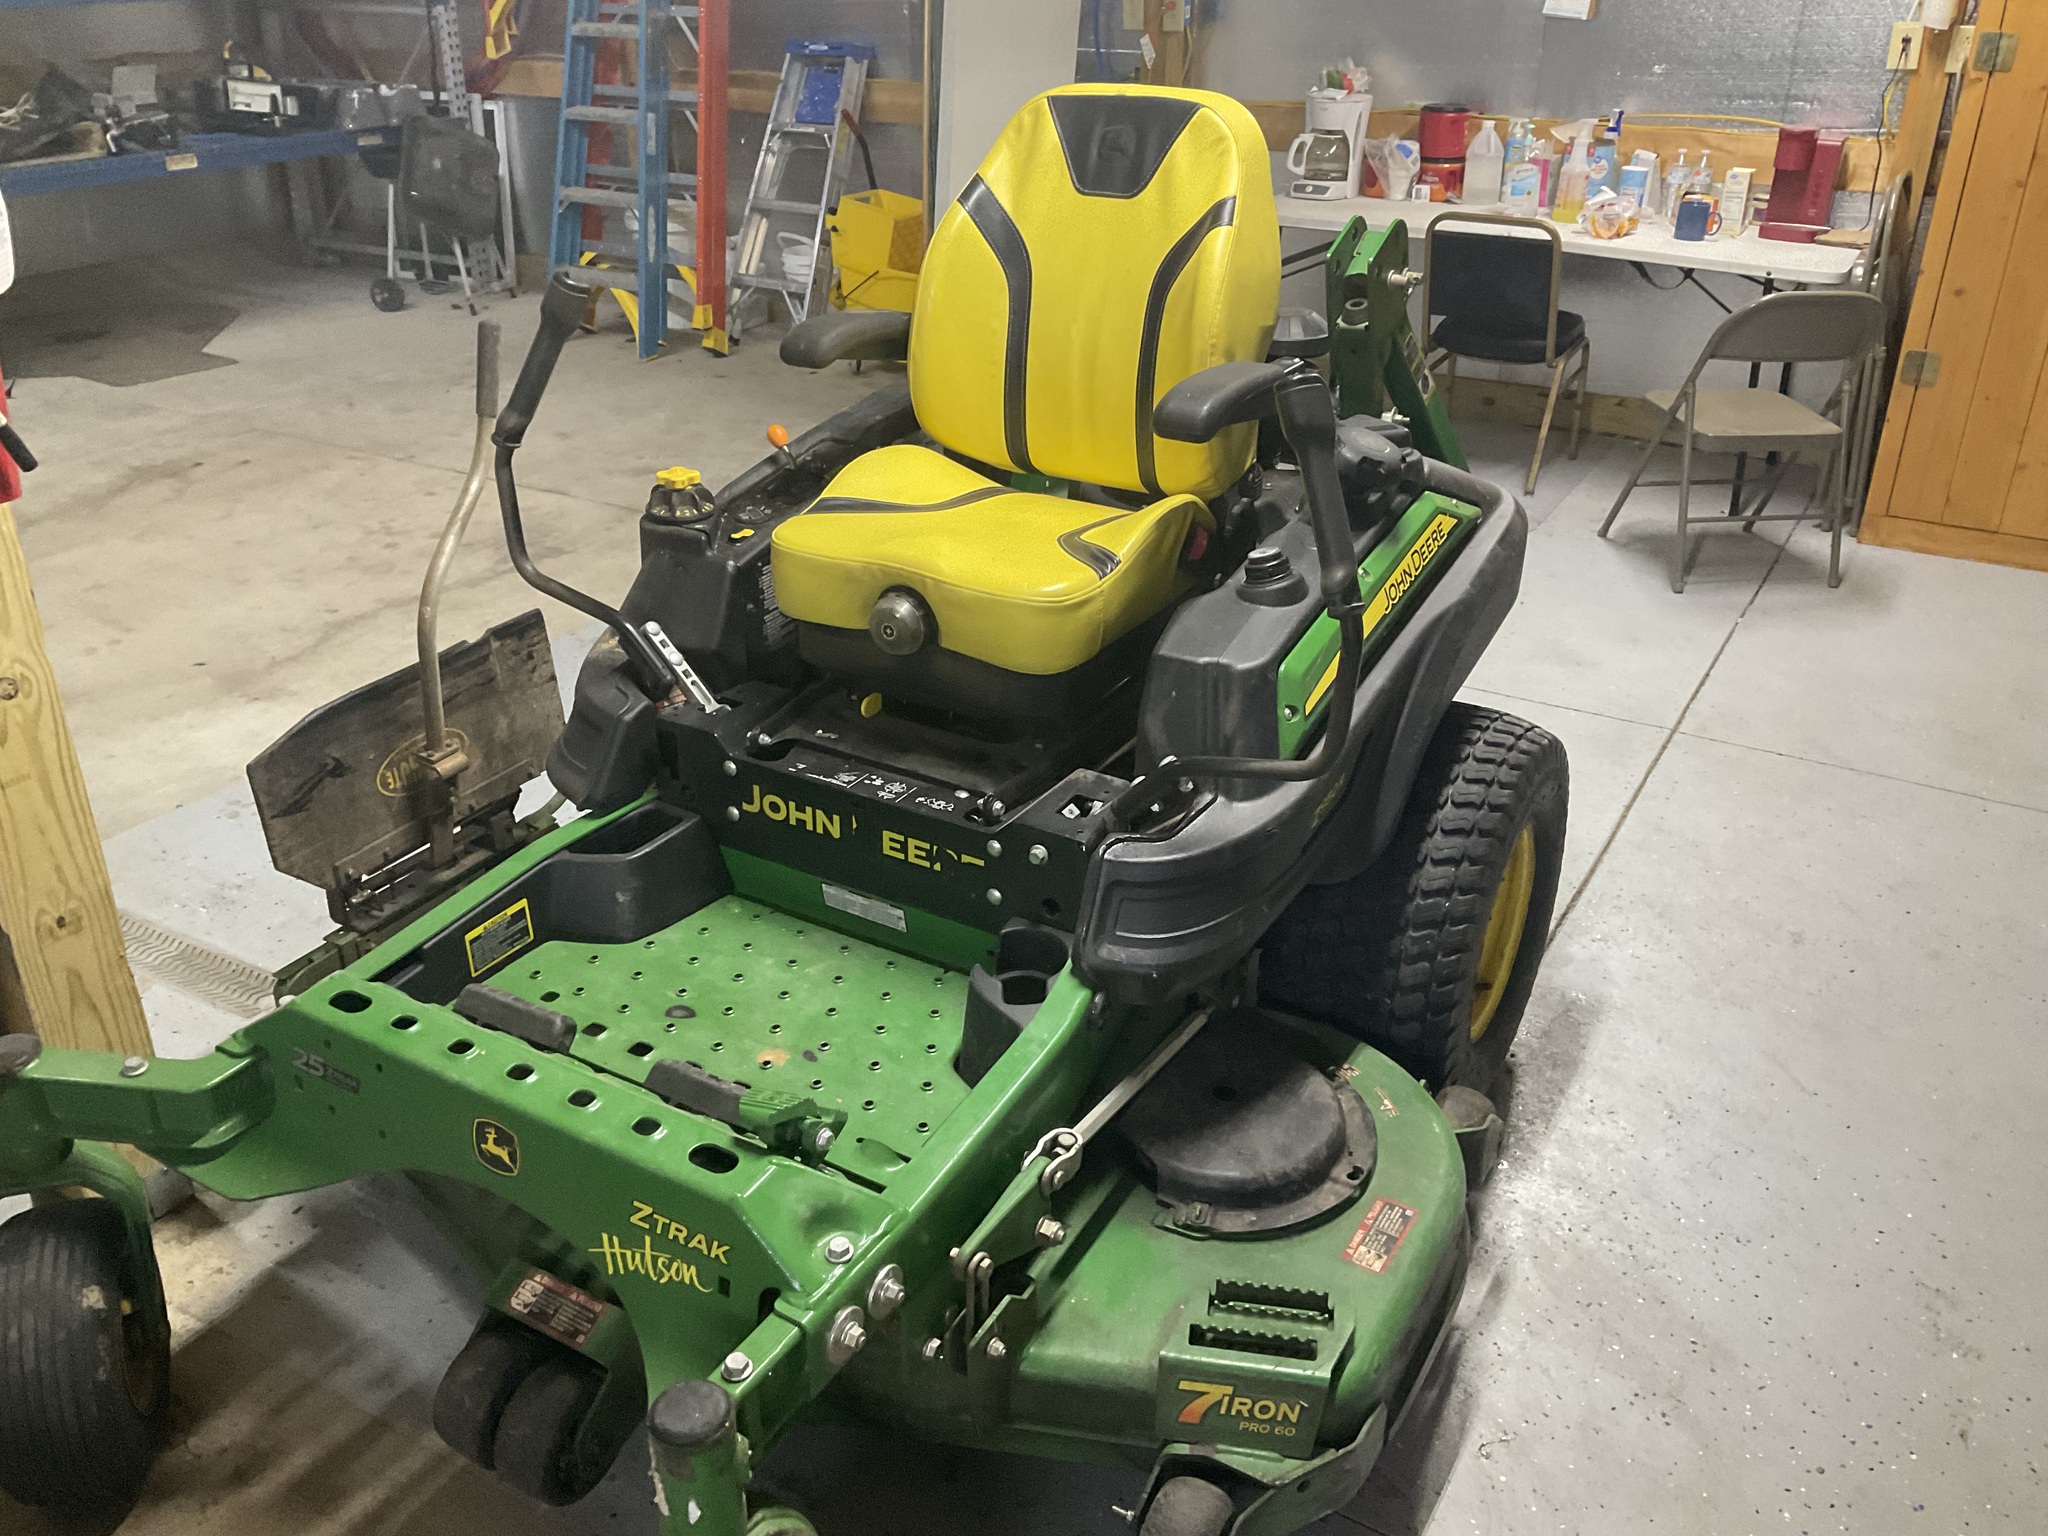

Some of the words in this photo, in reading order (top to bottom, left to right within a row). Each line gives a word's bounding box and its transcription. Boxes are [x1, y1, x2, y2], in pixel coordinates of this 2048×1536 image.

[1384, 563, 1413, 612] JOHN
[1411, 521, 1446, 572] DEERE
[742, 784, 841, 839] JOHN
[629, 1200, 731, 1265] ZTRAK
[1348, 1229, 1366, 1249] DANGER
[587, 1232, 714, 1293] Hutson
[1239, 1421, 1271, 1434] PRO
[1274, 1425, 1296, 1437] 60
